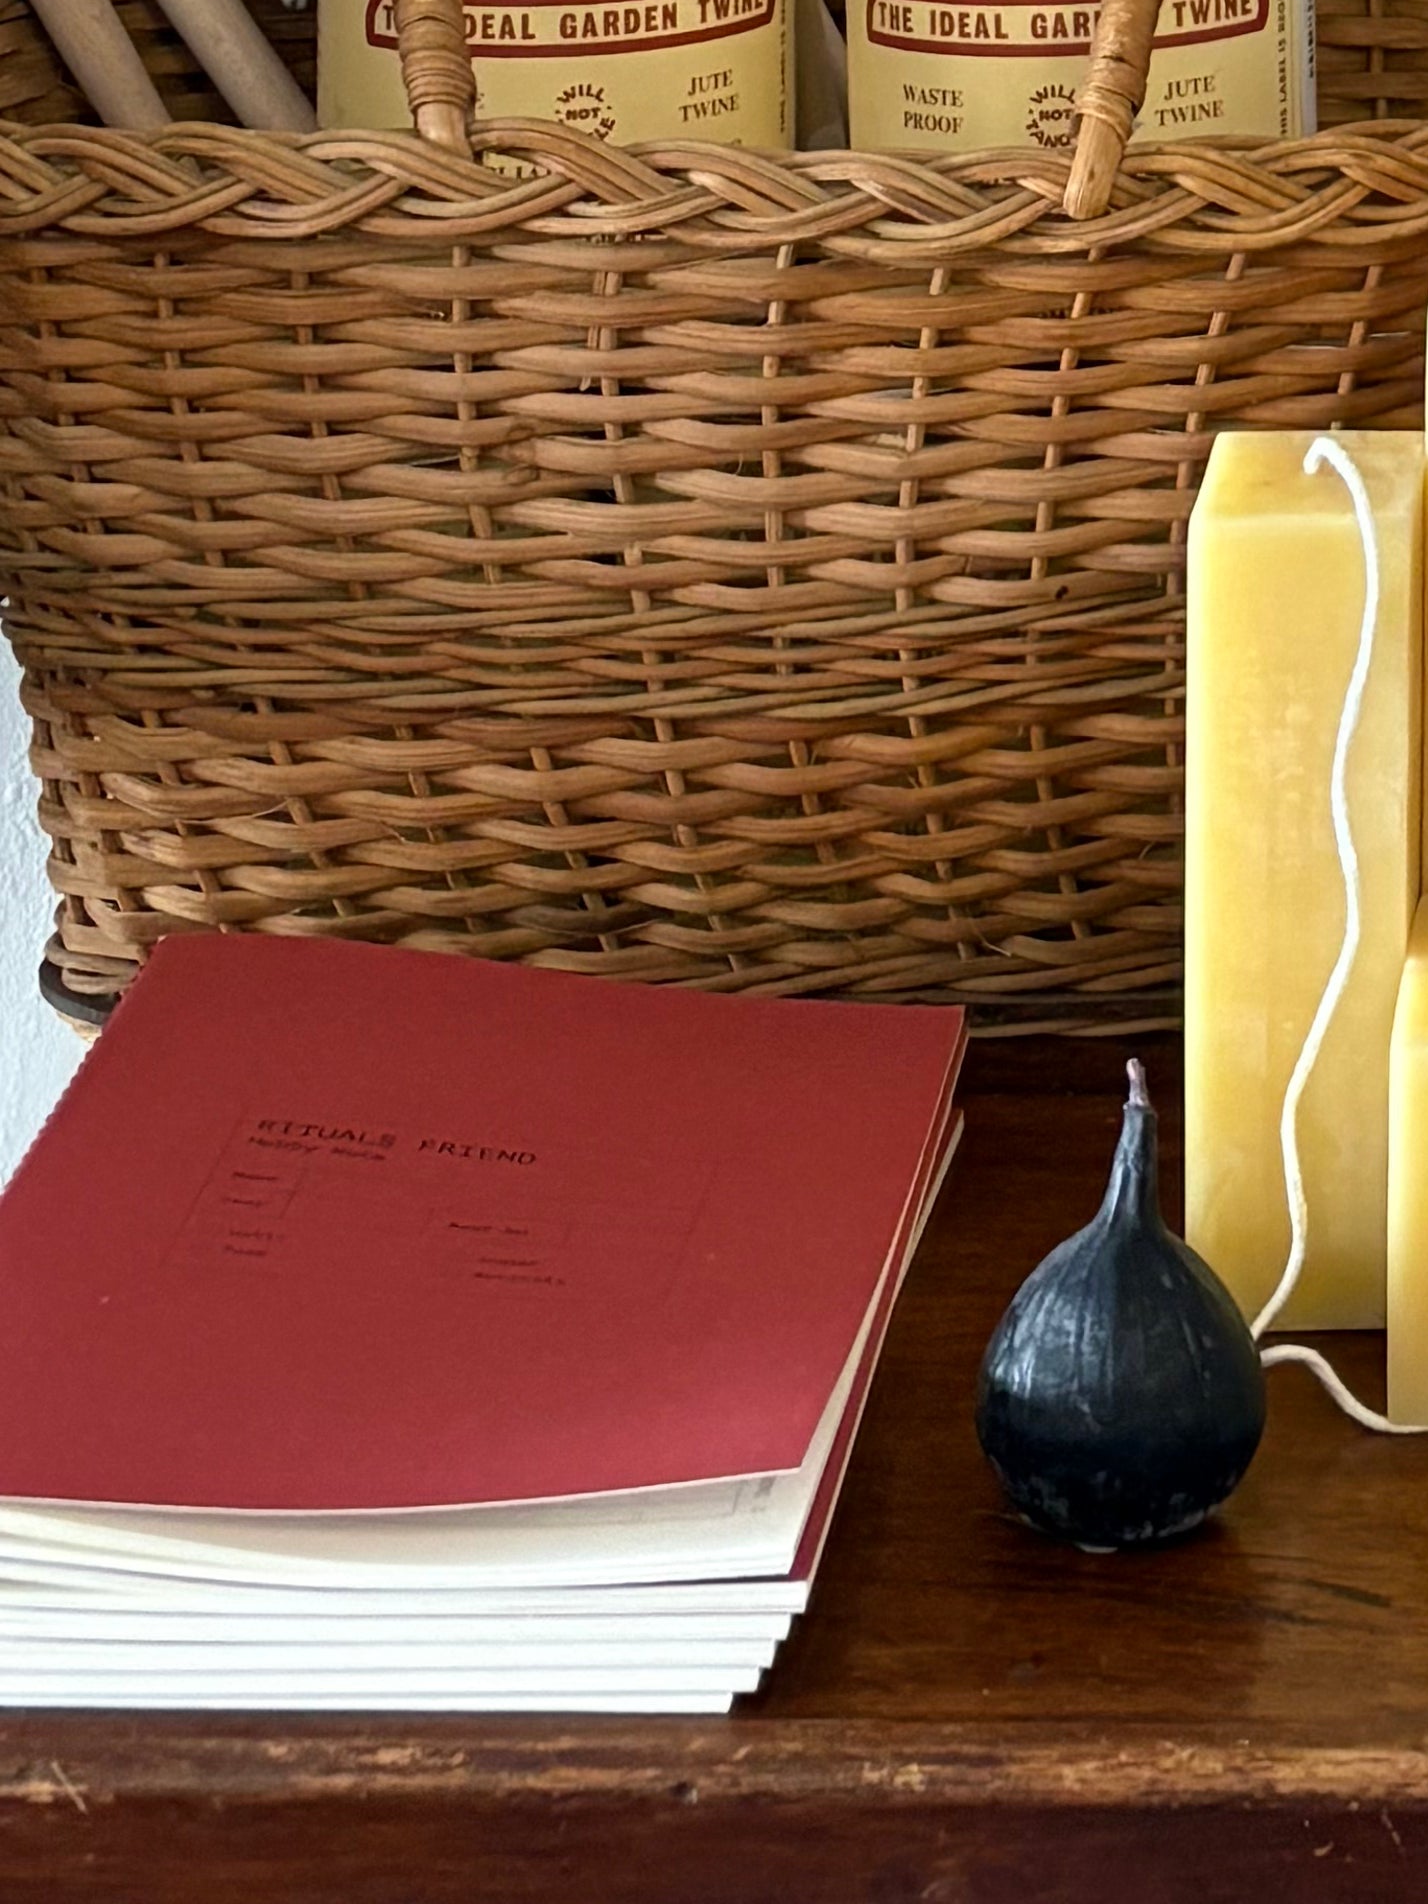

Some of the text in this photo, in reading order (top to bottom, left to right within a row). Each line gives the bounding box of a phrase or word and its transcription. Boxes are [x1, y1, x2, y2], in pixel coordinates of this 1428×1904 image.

[464, 13, 536, 40] DEAL
[560, 3, 678, 39] GARDEN
[878, 1, 914, 33] THE
[930, 10, 1009, 40] IDEAL
[557, 83, 604, 103] WILL
[688, 68, 734, 96] JUTE
[903, 83, 965, 108] WASTE
[1029, 83, 1075, 104] WILL
[1164, 75, 1217, 101] JUTE
[678, 94, 740, 123] TWINE
[903, 110, 965, 134] PROOF
[1154, 99, 1224, 127] TWINE
[418, 1139, 538, 1166] FRIEND
